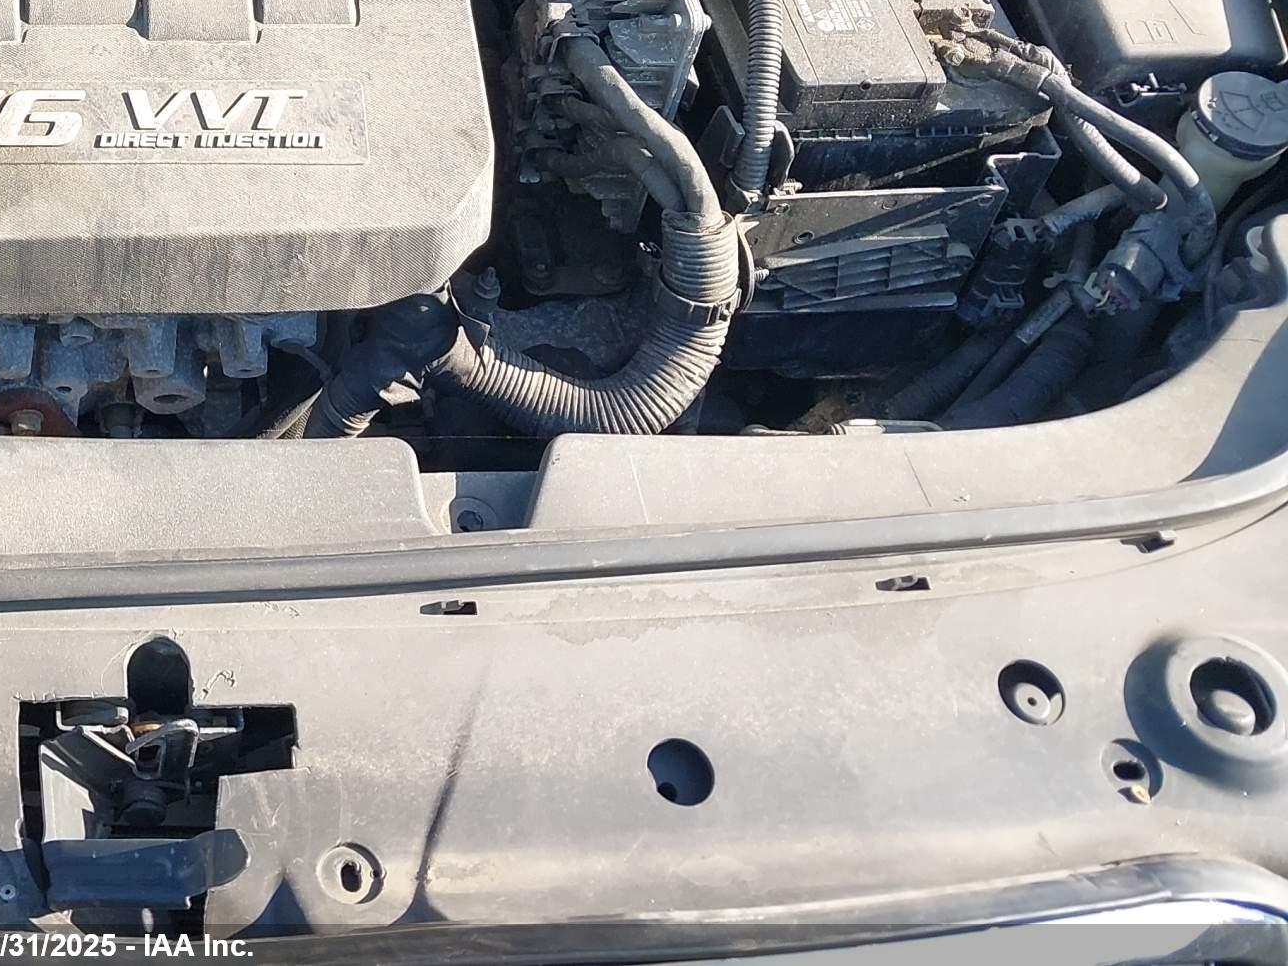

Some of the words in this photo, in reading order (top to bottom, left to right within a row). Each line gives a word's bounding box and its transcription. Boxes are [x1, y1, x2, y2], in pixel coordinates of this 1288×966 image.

[121, 89, 309, 130] VVT
[93, 133, 189, 149] DIRECT
[193, 133, 323, 149] INJECTION
